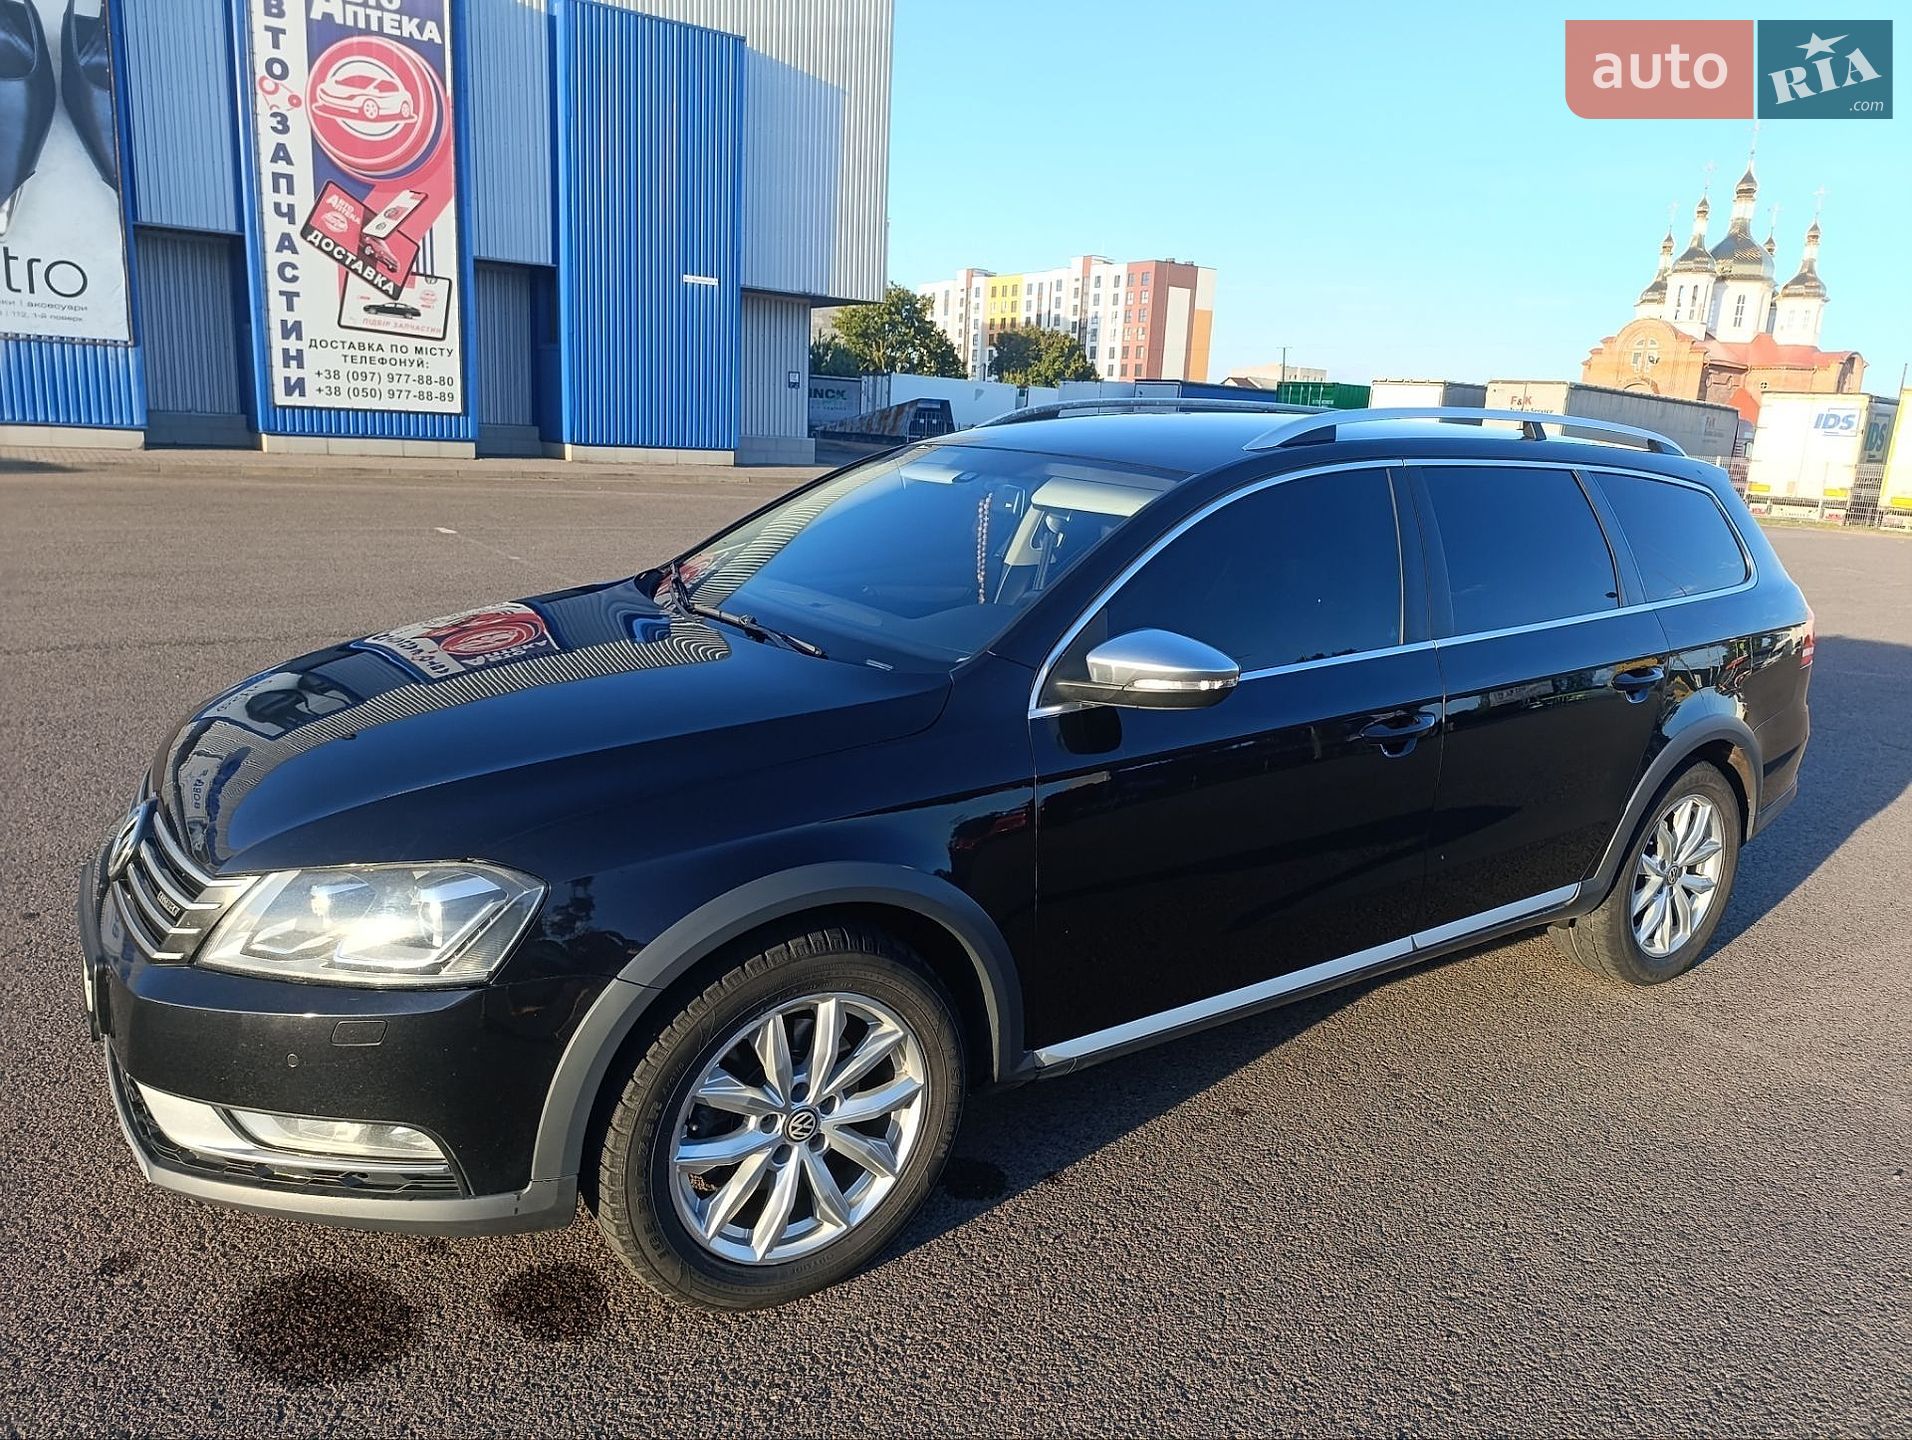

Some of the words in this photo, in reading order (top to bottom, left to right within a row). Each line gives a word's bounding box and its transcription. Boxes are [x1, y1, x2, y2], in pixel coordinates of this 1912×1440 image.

[306, 229, 396, 296] ДОСТАВКА
[3, 246, 88, 298] tro
[308, 338, 385, 353] ДОСТАВКА
[390, 344, 409, 354] ПО
[414, 346, 454, 358] МІСТУ
[341, 354, 430, 369] ТЕЛЕФОНУЙ:
[315, 369, 341, 380] +38
[346, 370, 382, 384] (097)
[387, 372, 454, 387] 977-88-80
[315, 385, 342, 396] +38
[347, 386, 383, 400] (050)
[387, 388, 455, 403] 977-88-89
[1813, 413, 1857, 430] IDS
